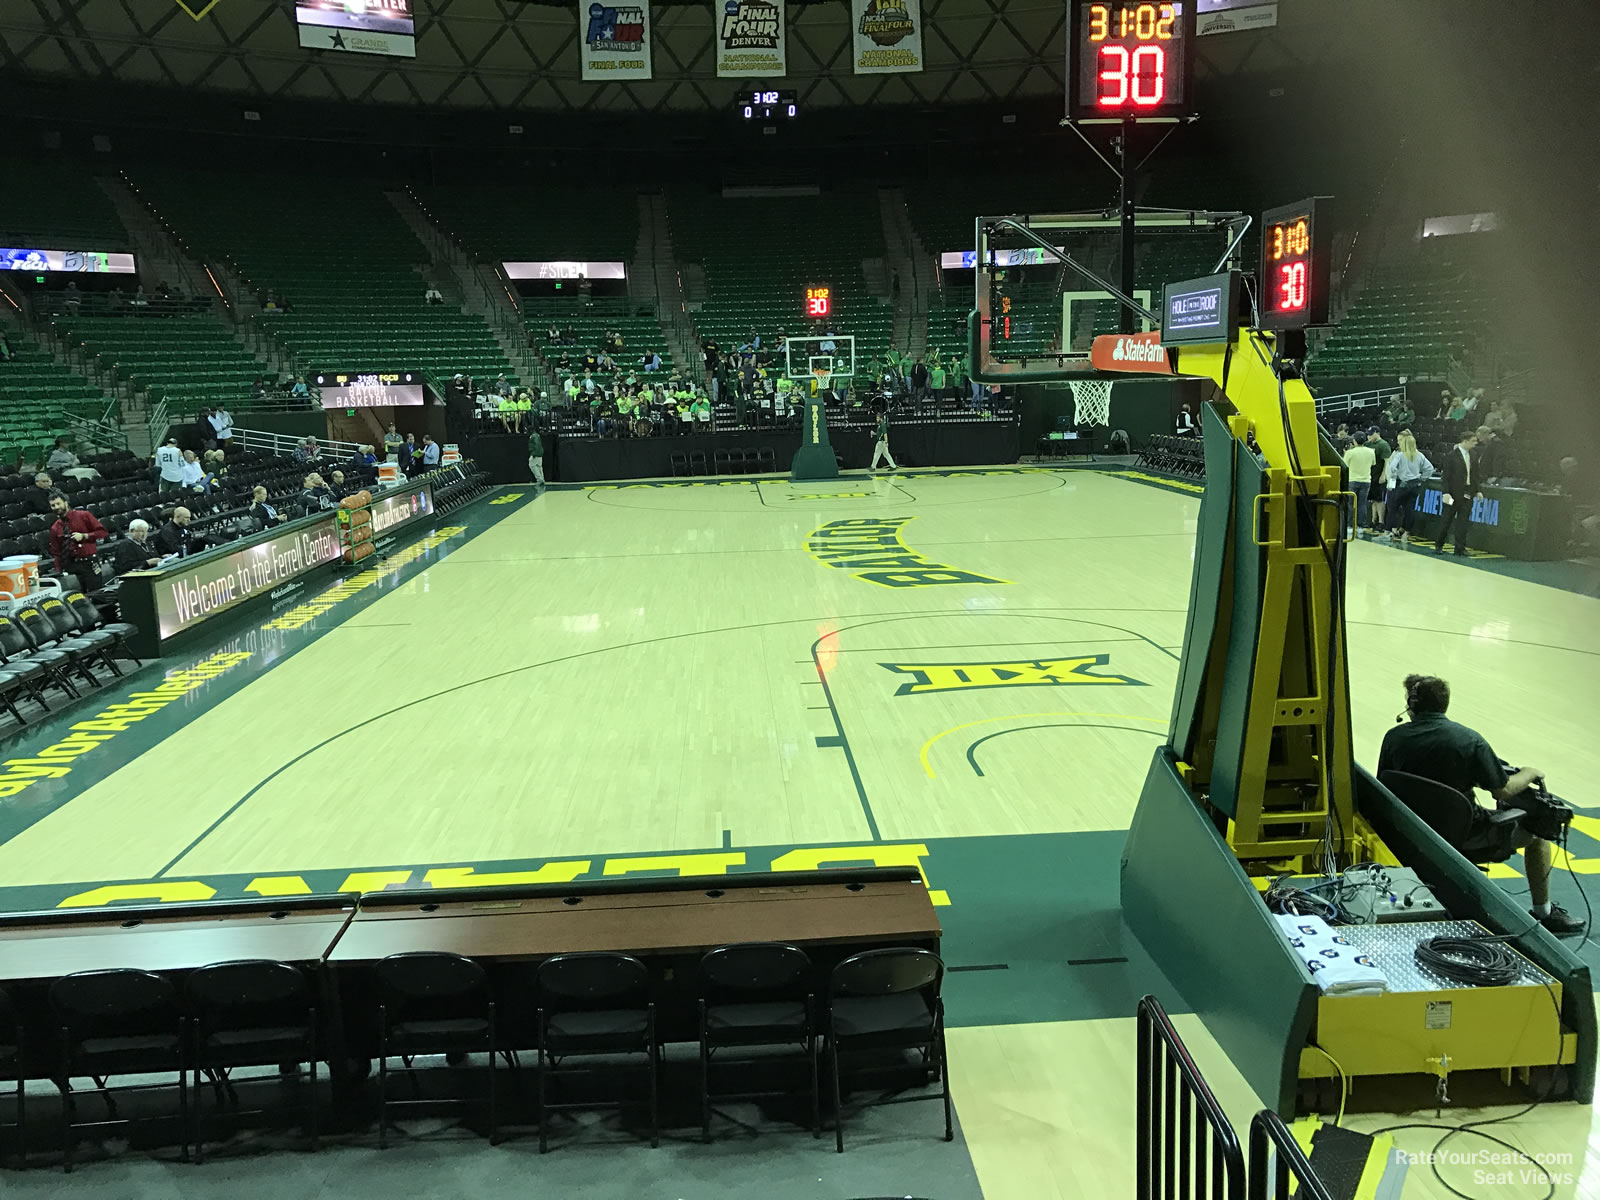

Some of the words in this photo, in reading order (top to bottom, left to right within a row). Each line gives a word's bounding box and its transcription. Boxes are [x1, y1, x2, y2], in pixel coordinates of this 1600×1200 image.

[738, 5, 777, 20] FINAL
[723, 15, 778, 38] FOUR
[863, 25, 890, 33] FINAL
[888, 20, 912, 29] FOUR
[1090, 5, 1176, 41] 31:02
[731, 37, 772, 47] DENVER
[862, 49, 914, 58] NATIONAL
[588, 60, 616, 70] FINAL
[618, 59, 645, 69] FOUR
[858, 57, 919, 68] CHAMPIONS
[1098, 45, 1165, 105] 30
[754, 91, 779, 104] 31:02
[744, 106, 752, 118] 0
[766, 108, 770, 117] 1
[788, 104, 796, 117] 0
[10, 259, 48, 271] FGCU
[1281, 262, 1305, 309] 30
[807, 288, 829, 299] 31:02
[809, 298, 827, 314] 30
[1171, 299, 1187, 315] HOLE
[1200, 294, 1218, 310] ROOF
[317, 376, 324, 384] 0
[336, 375, 348, 383] BU
[357, 375, 378, 383] 31:02
[379, 374, 399, 382] FGCU
[405, 374, 412, 382] 0
[348, 386, 387, 397] BAYLOR
[336, 395, 400, 408] BASKETBALL
[162, 453, 173, 463] 21
[1469, 496, 1499, 526] RENA
[803, 516, 1014, 588] BAYLOR
[171, 574, 236, 623] Welcome
[237, 563, 252, 594] to
[252, 552, 272, 588] the
[271, 535, 304, 580] Ferrell
[302, 533, 332, 566] Center
